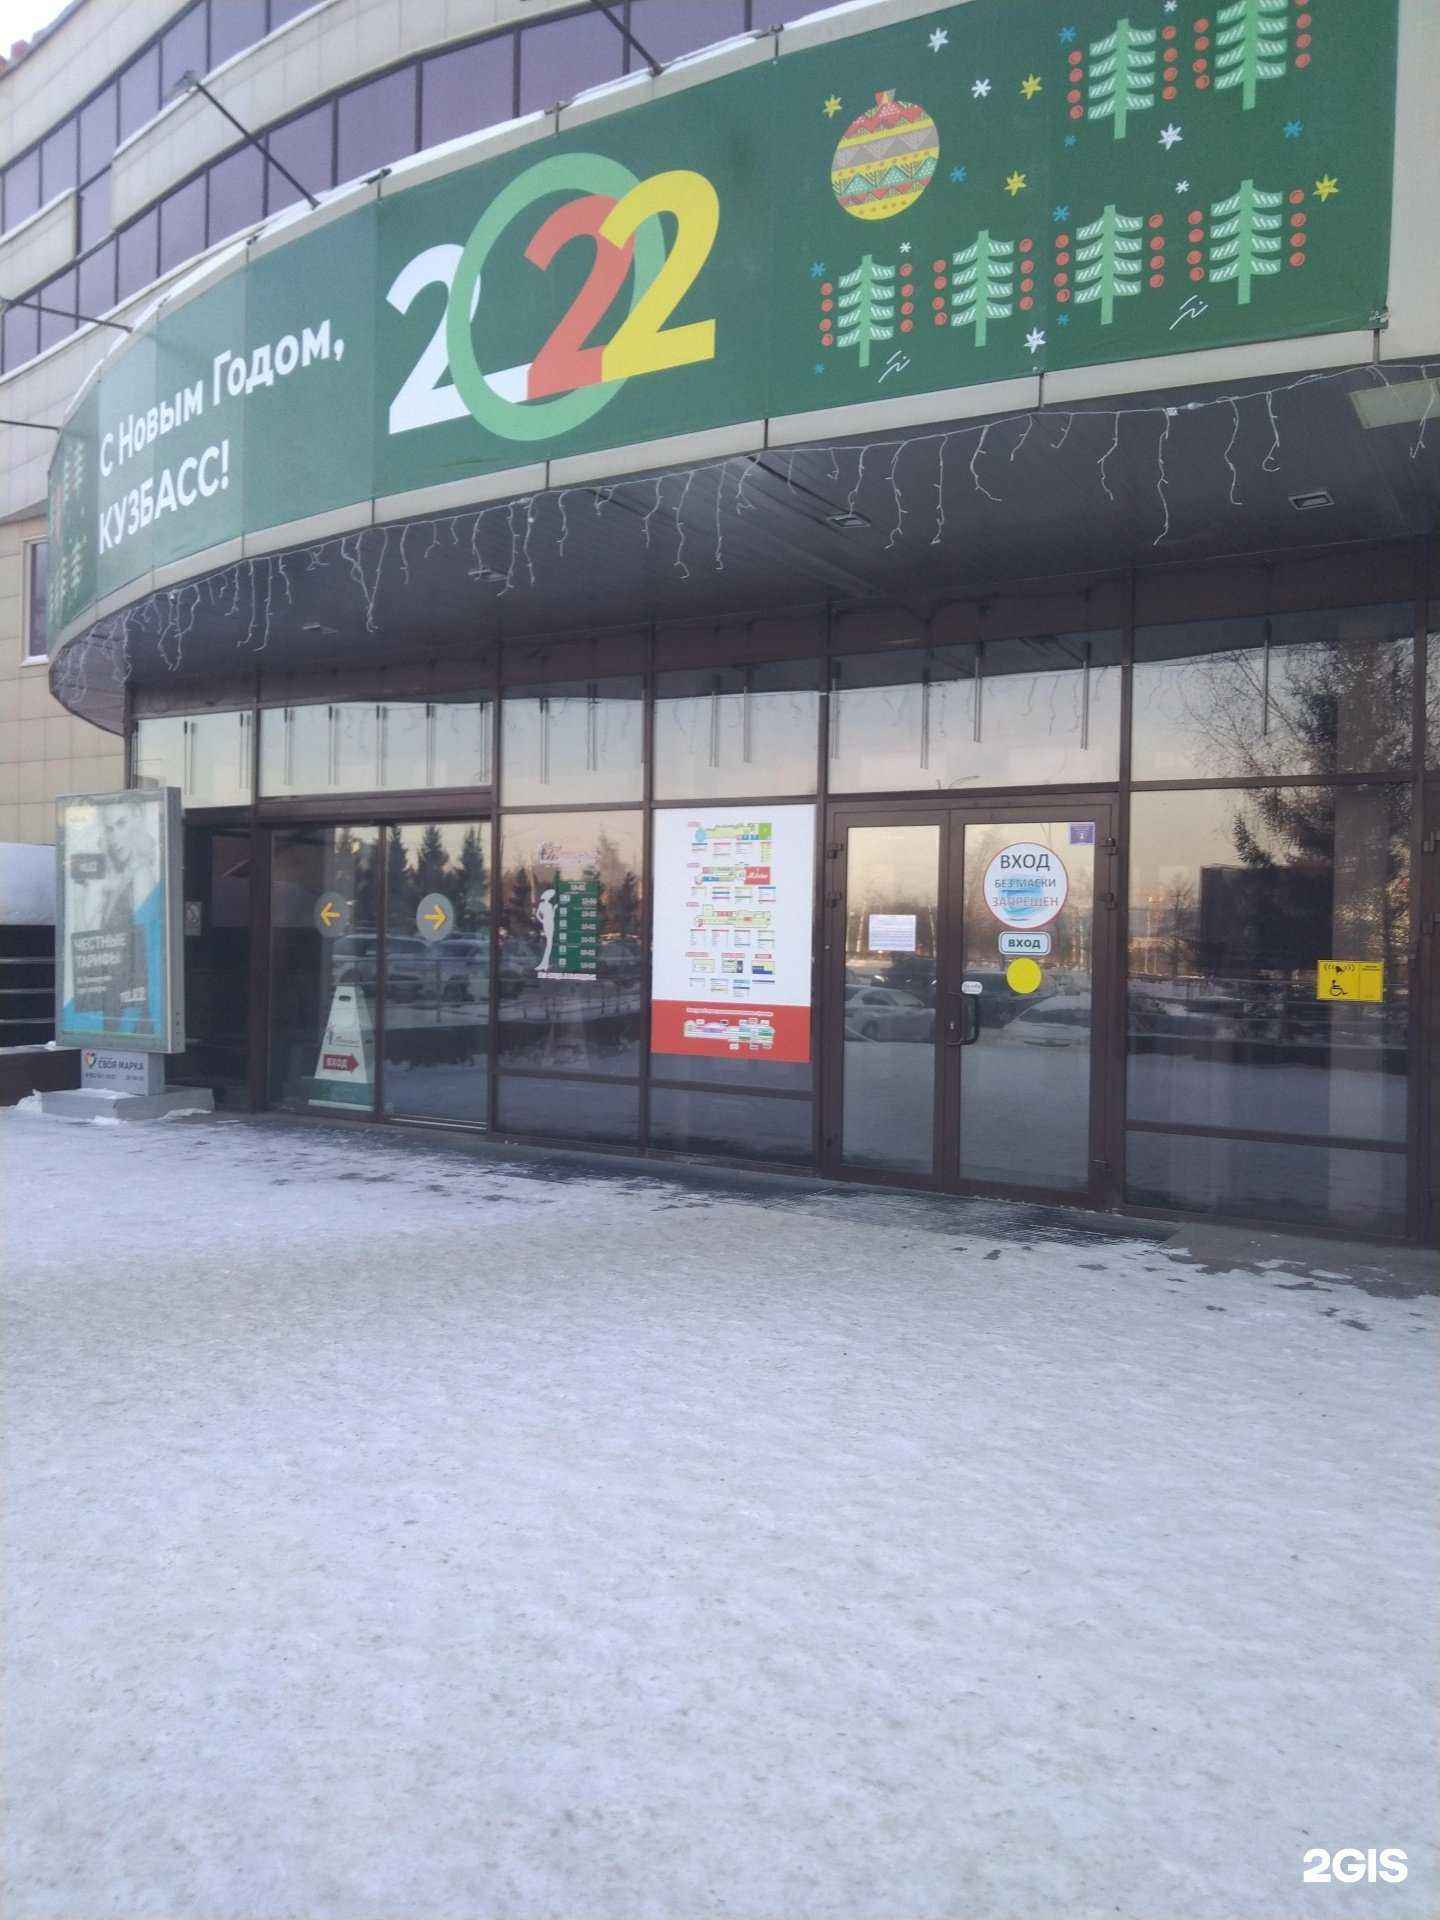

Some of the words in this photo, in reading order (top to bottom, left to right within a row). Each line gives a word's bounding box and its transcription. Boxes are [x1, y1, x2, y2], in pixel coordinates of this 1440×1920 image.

[386, 152, 720, 441] 2022
[100, 432, 114, 477] С
[118, 379, 204, 466] Новым
[213, 319, 345, 407] Годом,
[99, 439, 229, 555] КУЗБАСС!
[1000, 854, 1051, 872] ВХОД
[994, 879, 1018, 889] БЕЗ
[1019, 878, 1057, 889] МАСКИ
[992, 896, 1059, 908] ЗАПРЕЩЕН
[1008, 937, 1041, 950] ВХОД
